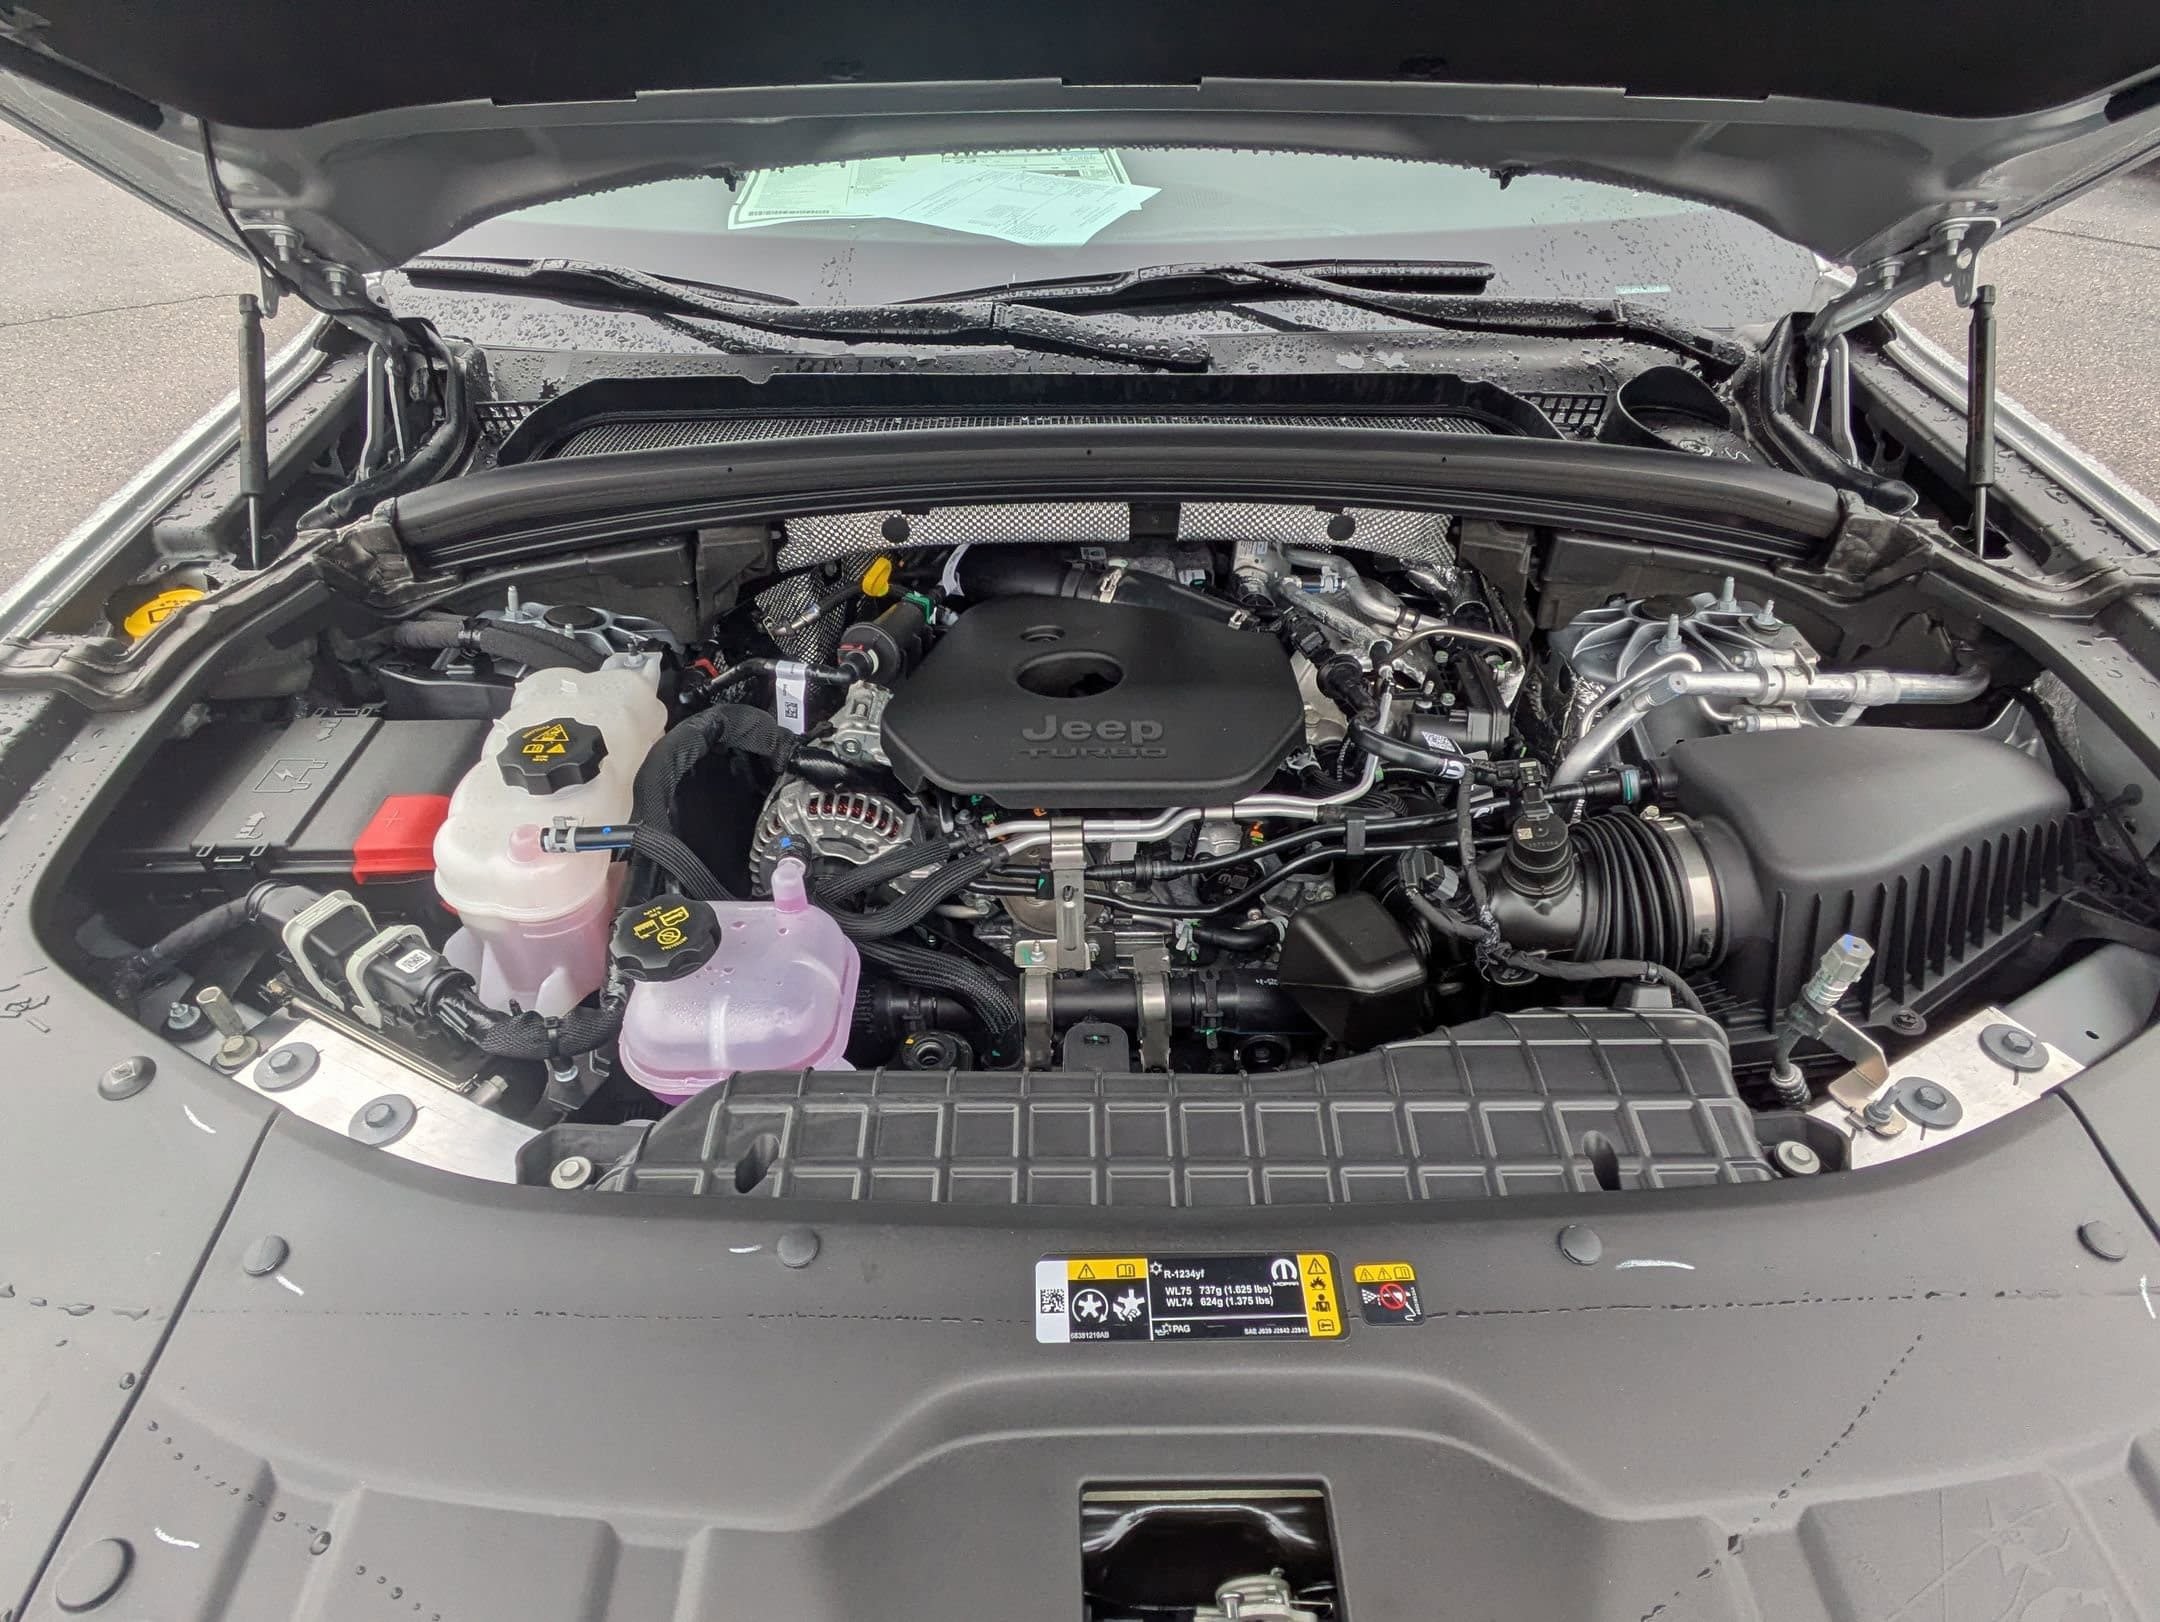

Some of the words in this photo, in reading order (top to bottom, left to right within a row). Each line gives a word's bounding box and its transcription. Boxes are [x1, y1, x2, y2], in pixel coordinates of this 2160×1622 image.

[1022, 714, 1164, 746] Jeep
[1017, 747, 1168, 760] TURBO
[1163, 1269, 1205, 1280] R-1234yf
[1165, 1286, 1193, 1296] WL75
[1199, 1285, 1223, 1297] 737g
[1224, 1284, 1253, 1296] (1.625
[1254, 1284, 1273, 1296] lbs)
[1166, 1297, 1194, 1307] WL74
[1200, 1296, 1224, 1308] 624g
[1225, 1296, 1254, 1308] (1.375
[1255, 1295, 1275, 1307] lbs)
[1172, 1324, 1192, 1334] PAG
